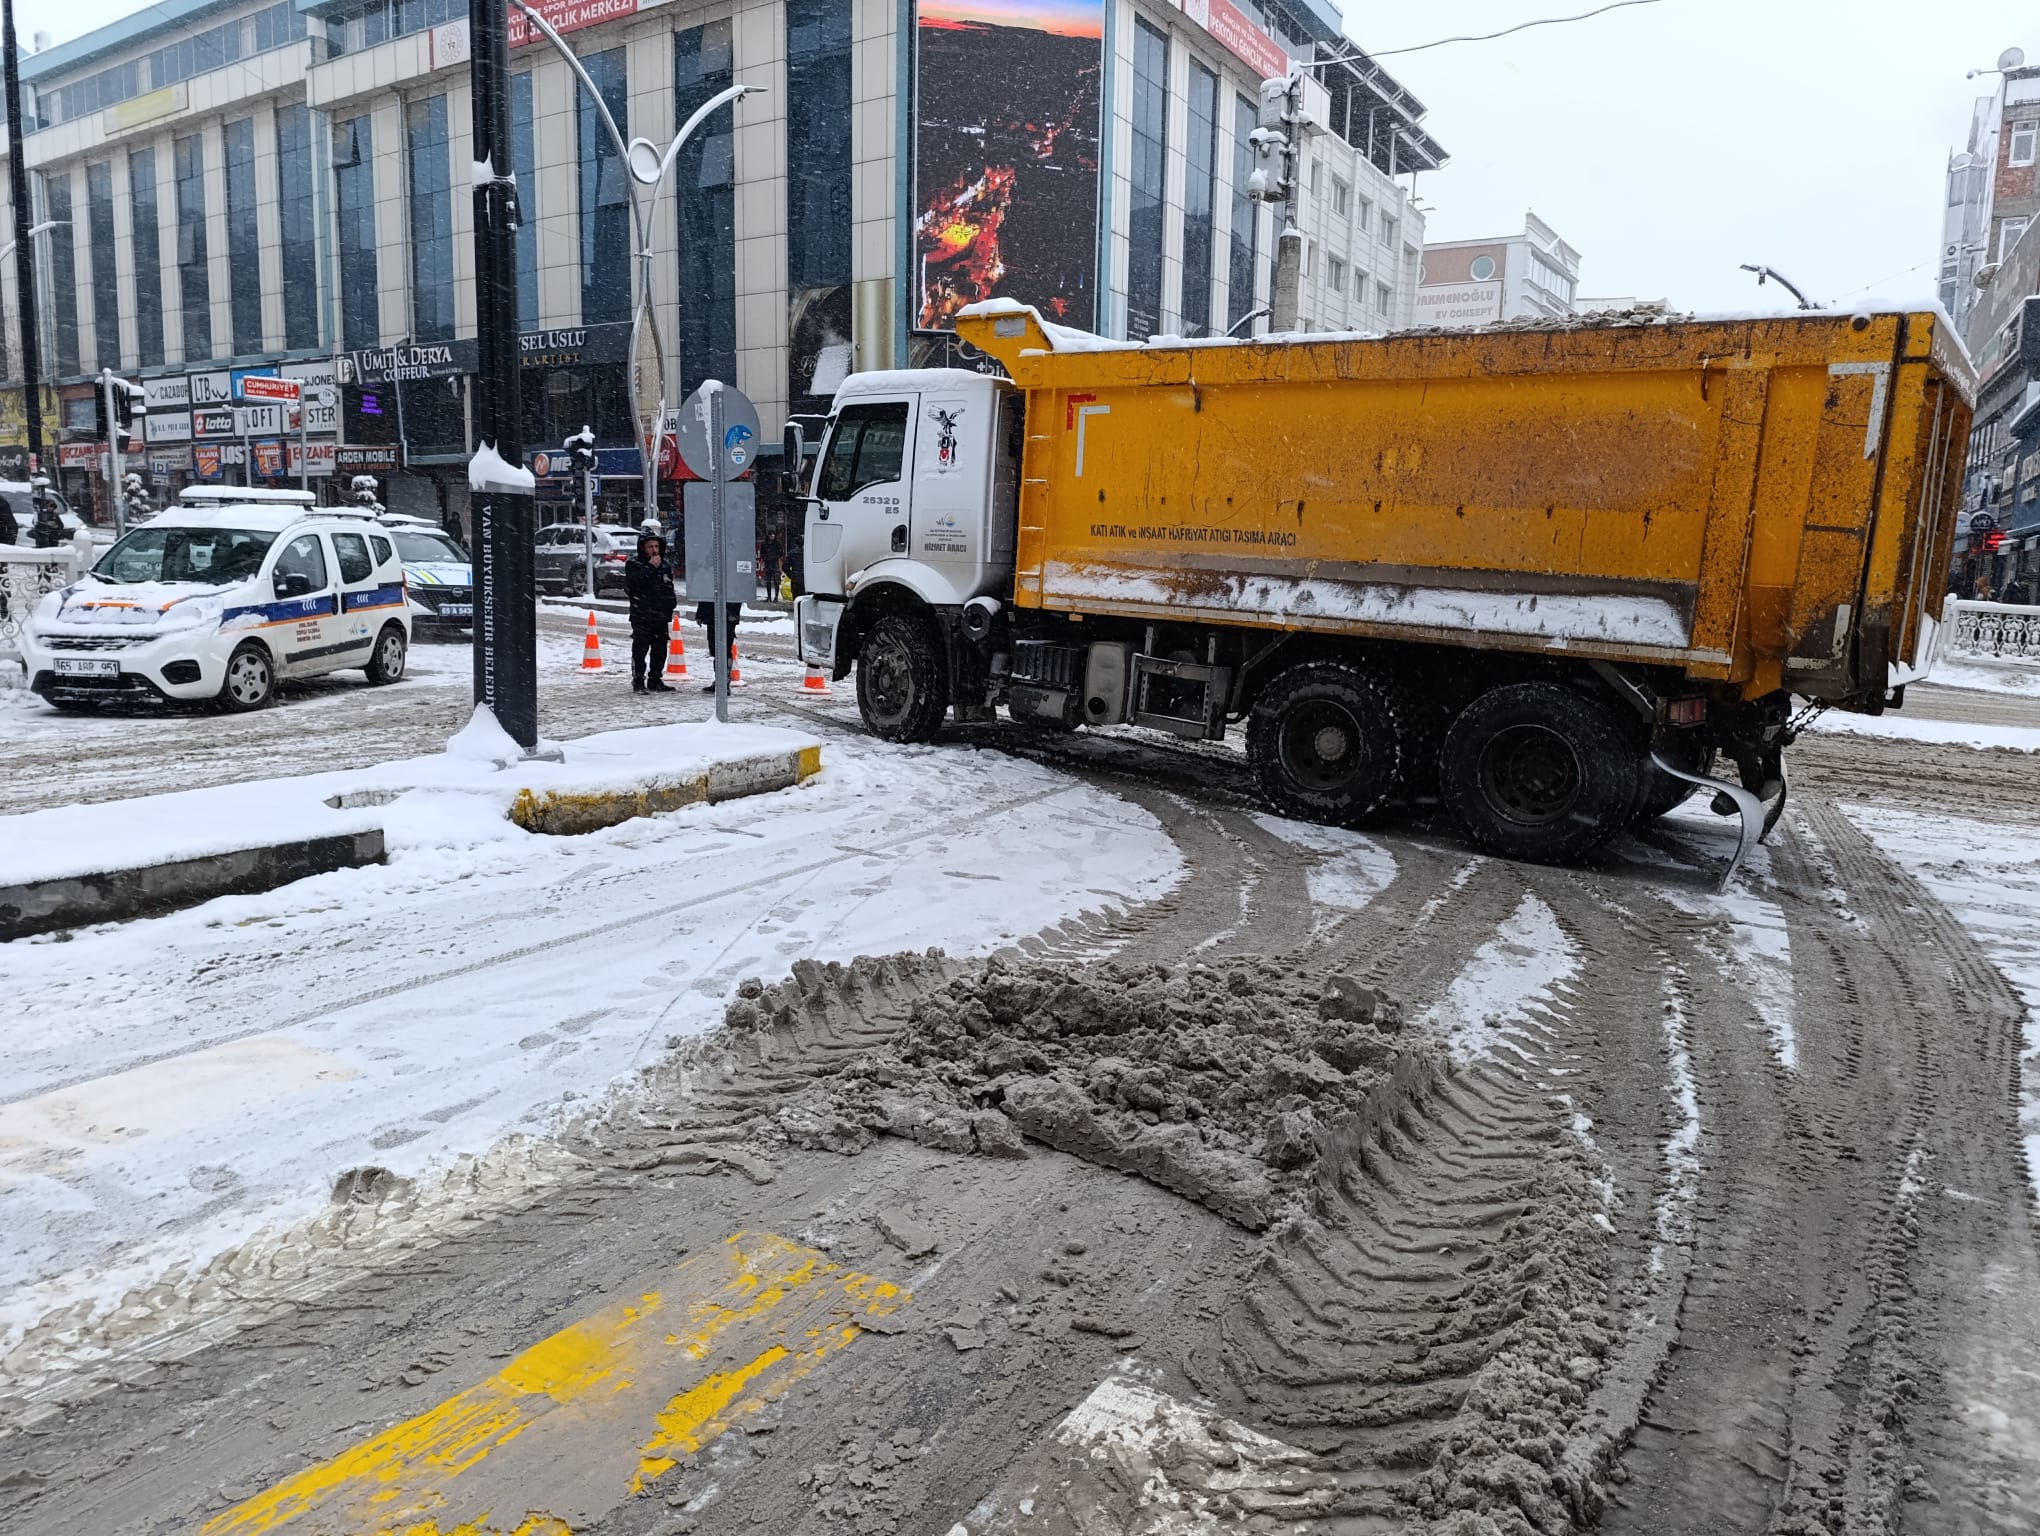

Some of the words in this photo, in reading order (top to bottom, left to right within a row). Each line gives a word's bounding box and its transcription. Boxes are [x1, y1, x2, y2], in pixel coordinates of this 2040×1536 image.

[1435, 310, 1448, 320] EV
[519, 334, 546, 351] SEL
[548, 330, 587, 349] USLU
[362, 350, 395, 371] ÜMİT
[410, 346, 453, 365] DERYA
[205, 416, 232, 430] Lotto
[337, 451, 364, 464] ARDEN
[365, 450, 396, 463] MOBILE
[863, 496, 891, 505] 2532
[892, 497, 900, 505] D
[885, 506, 900, 514] E5
[482, 505, 492, 539] VAN
[1090, 523, 1108, 538] KATI
[1109, 525, 1127, 539] ATIK
[1127, 528, 1137, 539] ve
[1267, 531, 1296, 547] ARACI
[60, 661, 72, 671] 65
